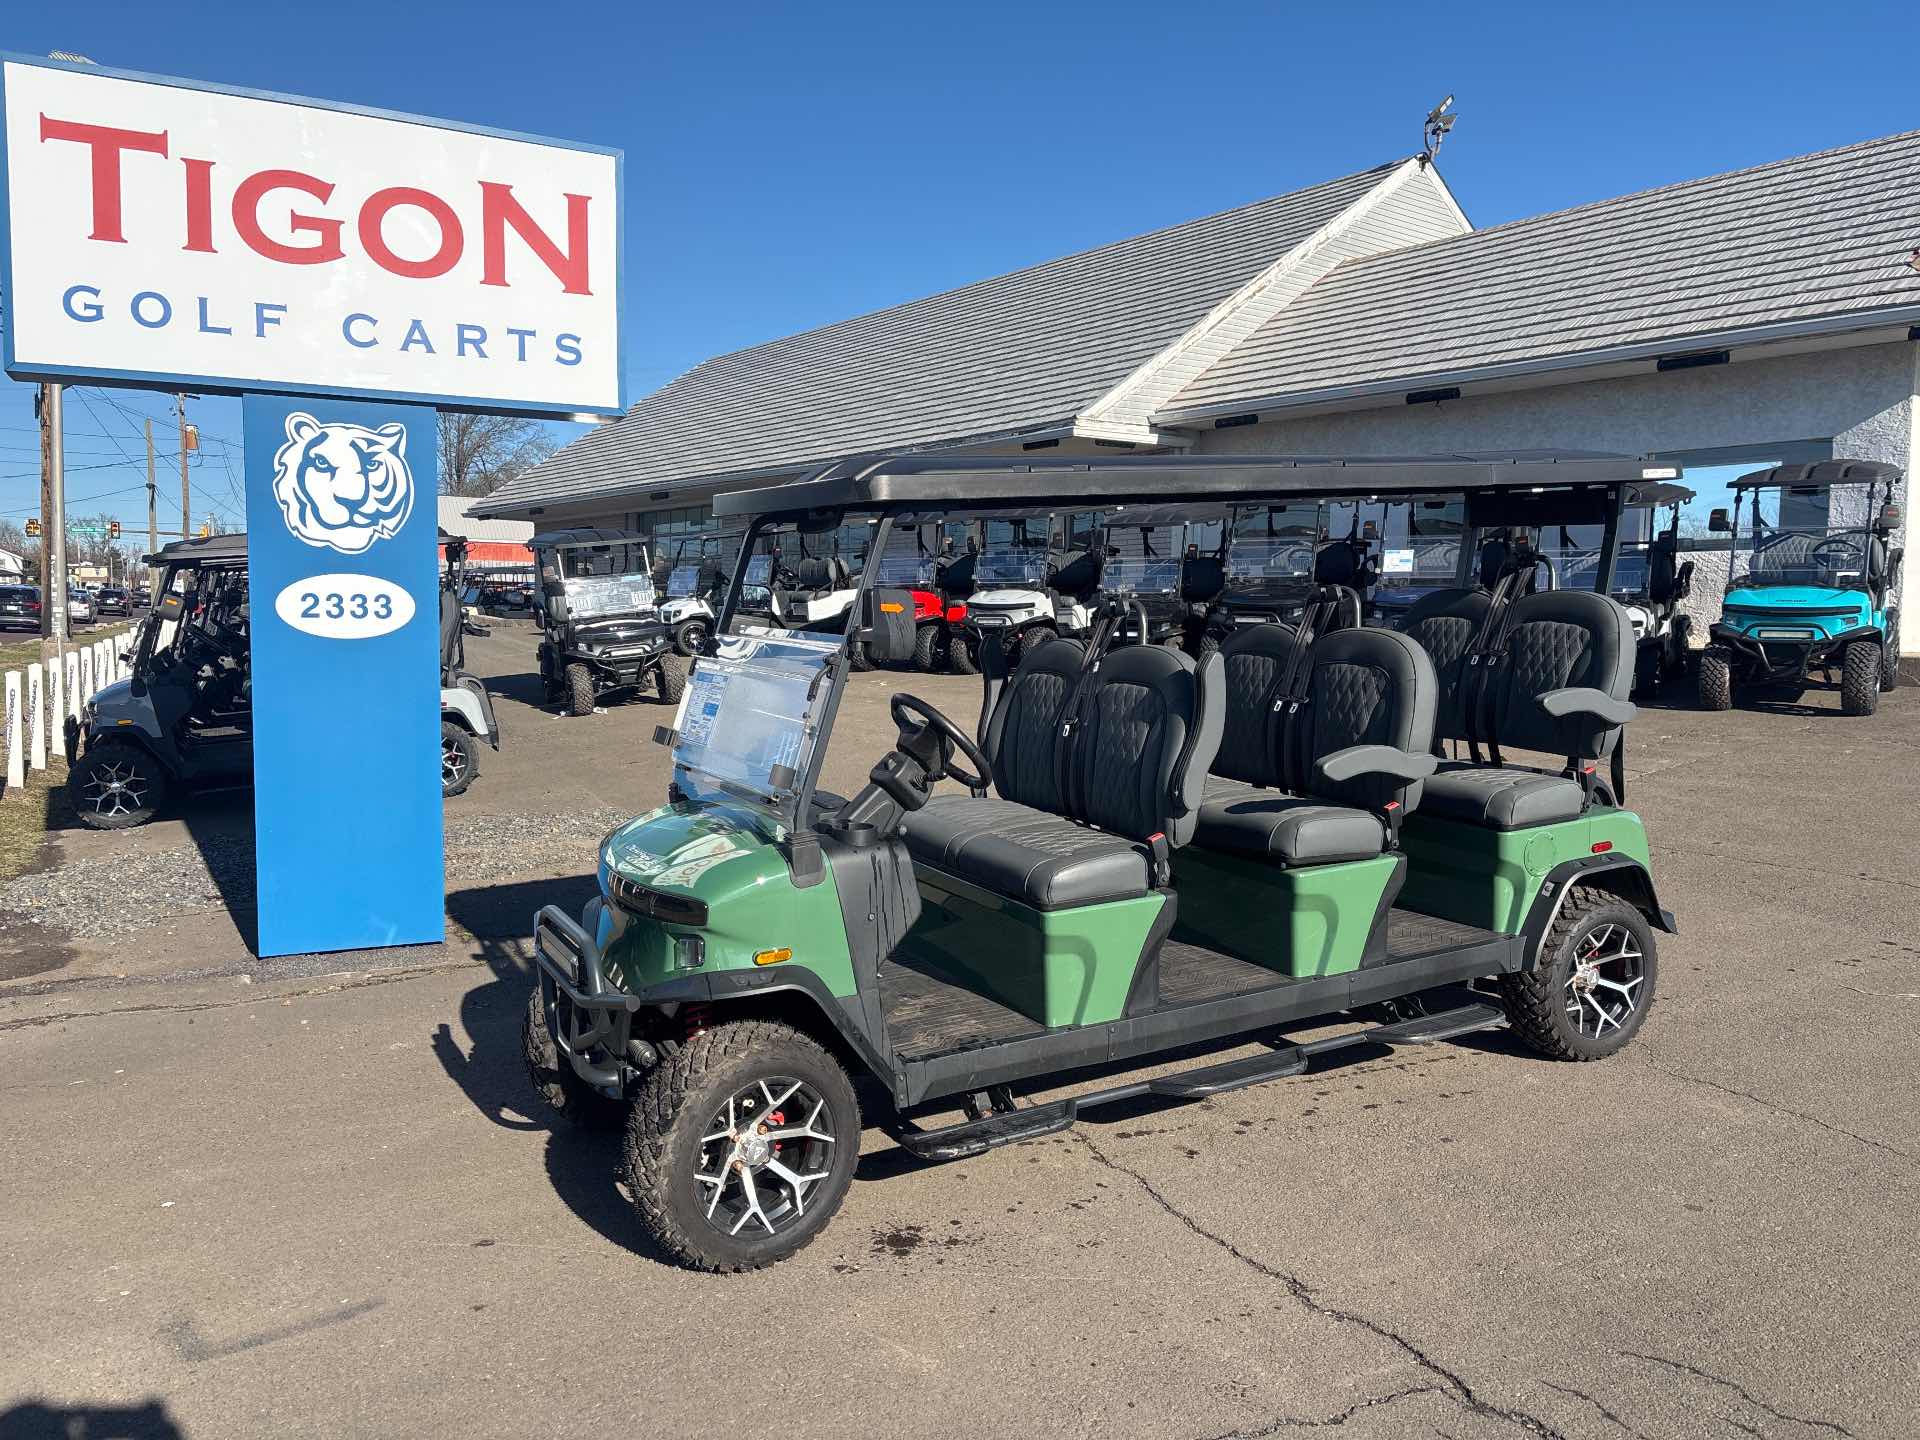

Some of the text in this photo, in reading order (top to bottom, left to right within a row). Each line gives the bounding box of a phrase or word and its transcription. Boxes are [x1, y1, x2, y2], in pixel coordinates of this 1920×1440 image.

[39, 112, 593, 296] TIGON
[62, 284, 583, 366] GOLF CARTS
[300, 592, 392, 619] 2333
